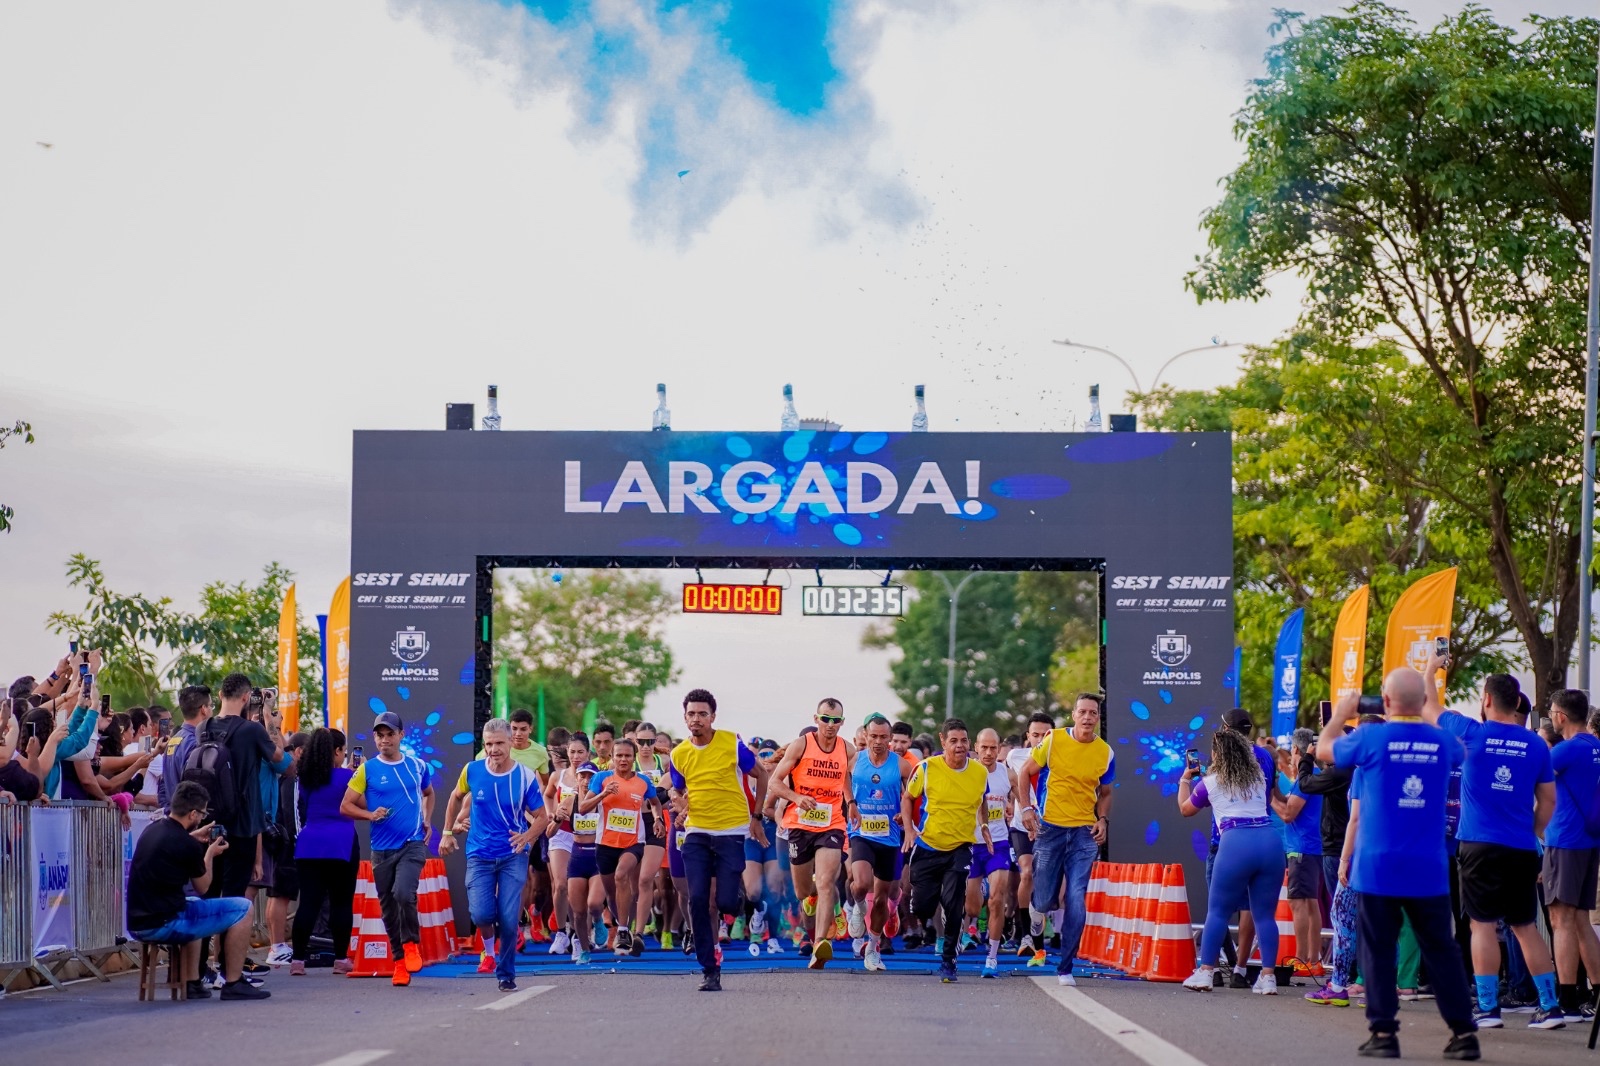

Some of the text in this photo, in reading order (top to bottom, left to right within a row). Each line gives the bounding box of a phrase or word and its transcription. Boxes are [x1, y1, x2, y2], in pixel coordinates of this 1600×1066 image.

[564, 460, 983, 515] LARGADA!
[353, 573, 470, 586] SEST SENAT
[1111, 576, 1230, 589] SEST SENAT
[357, 595, 378, 603] CNT
[384, 595, 410, 603] SEST
[412, 595, 445, 603] SENAT
[685, 586, 780, 612] 00:00:00
[1116, 599, 1227, 607] CNT SEST SENAT ITL
[382, 667, 439, 676] ANÁPOLIS
[1143, 670, 1201, 680] ANÁPOLIS
[1388, 742, 1439, 752] SEST SENAT
[813, 758, 839, 769] UNIÃO
[807, 769, 842, 779] RUNNING
[576, 820, 595, 829] 7506
[612, 816, 632, 825] 7507
[865, 821, 886, 829] 1002
